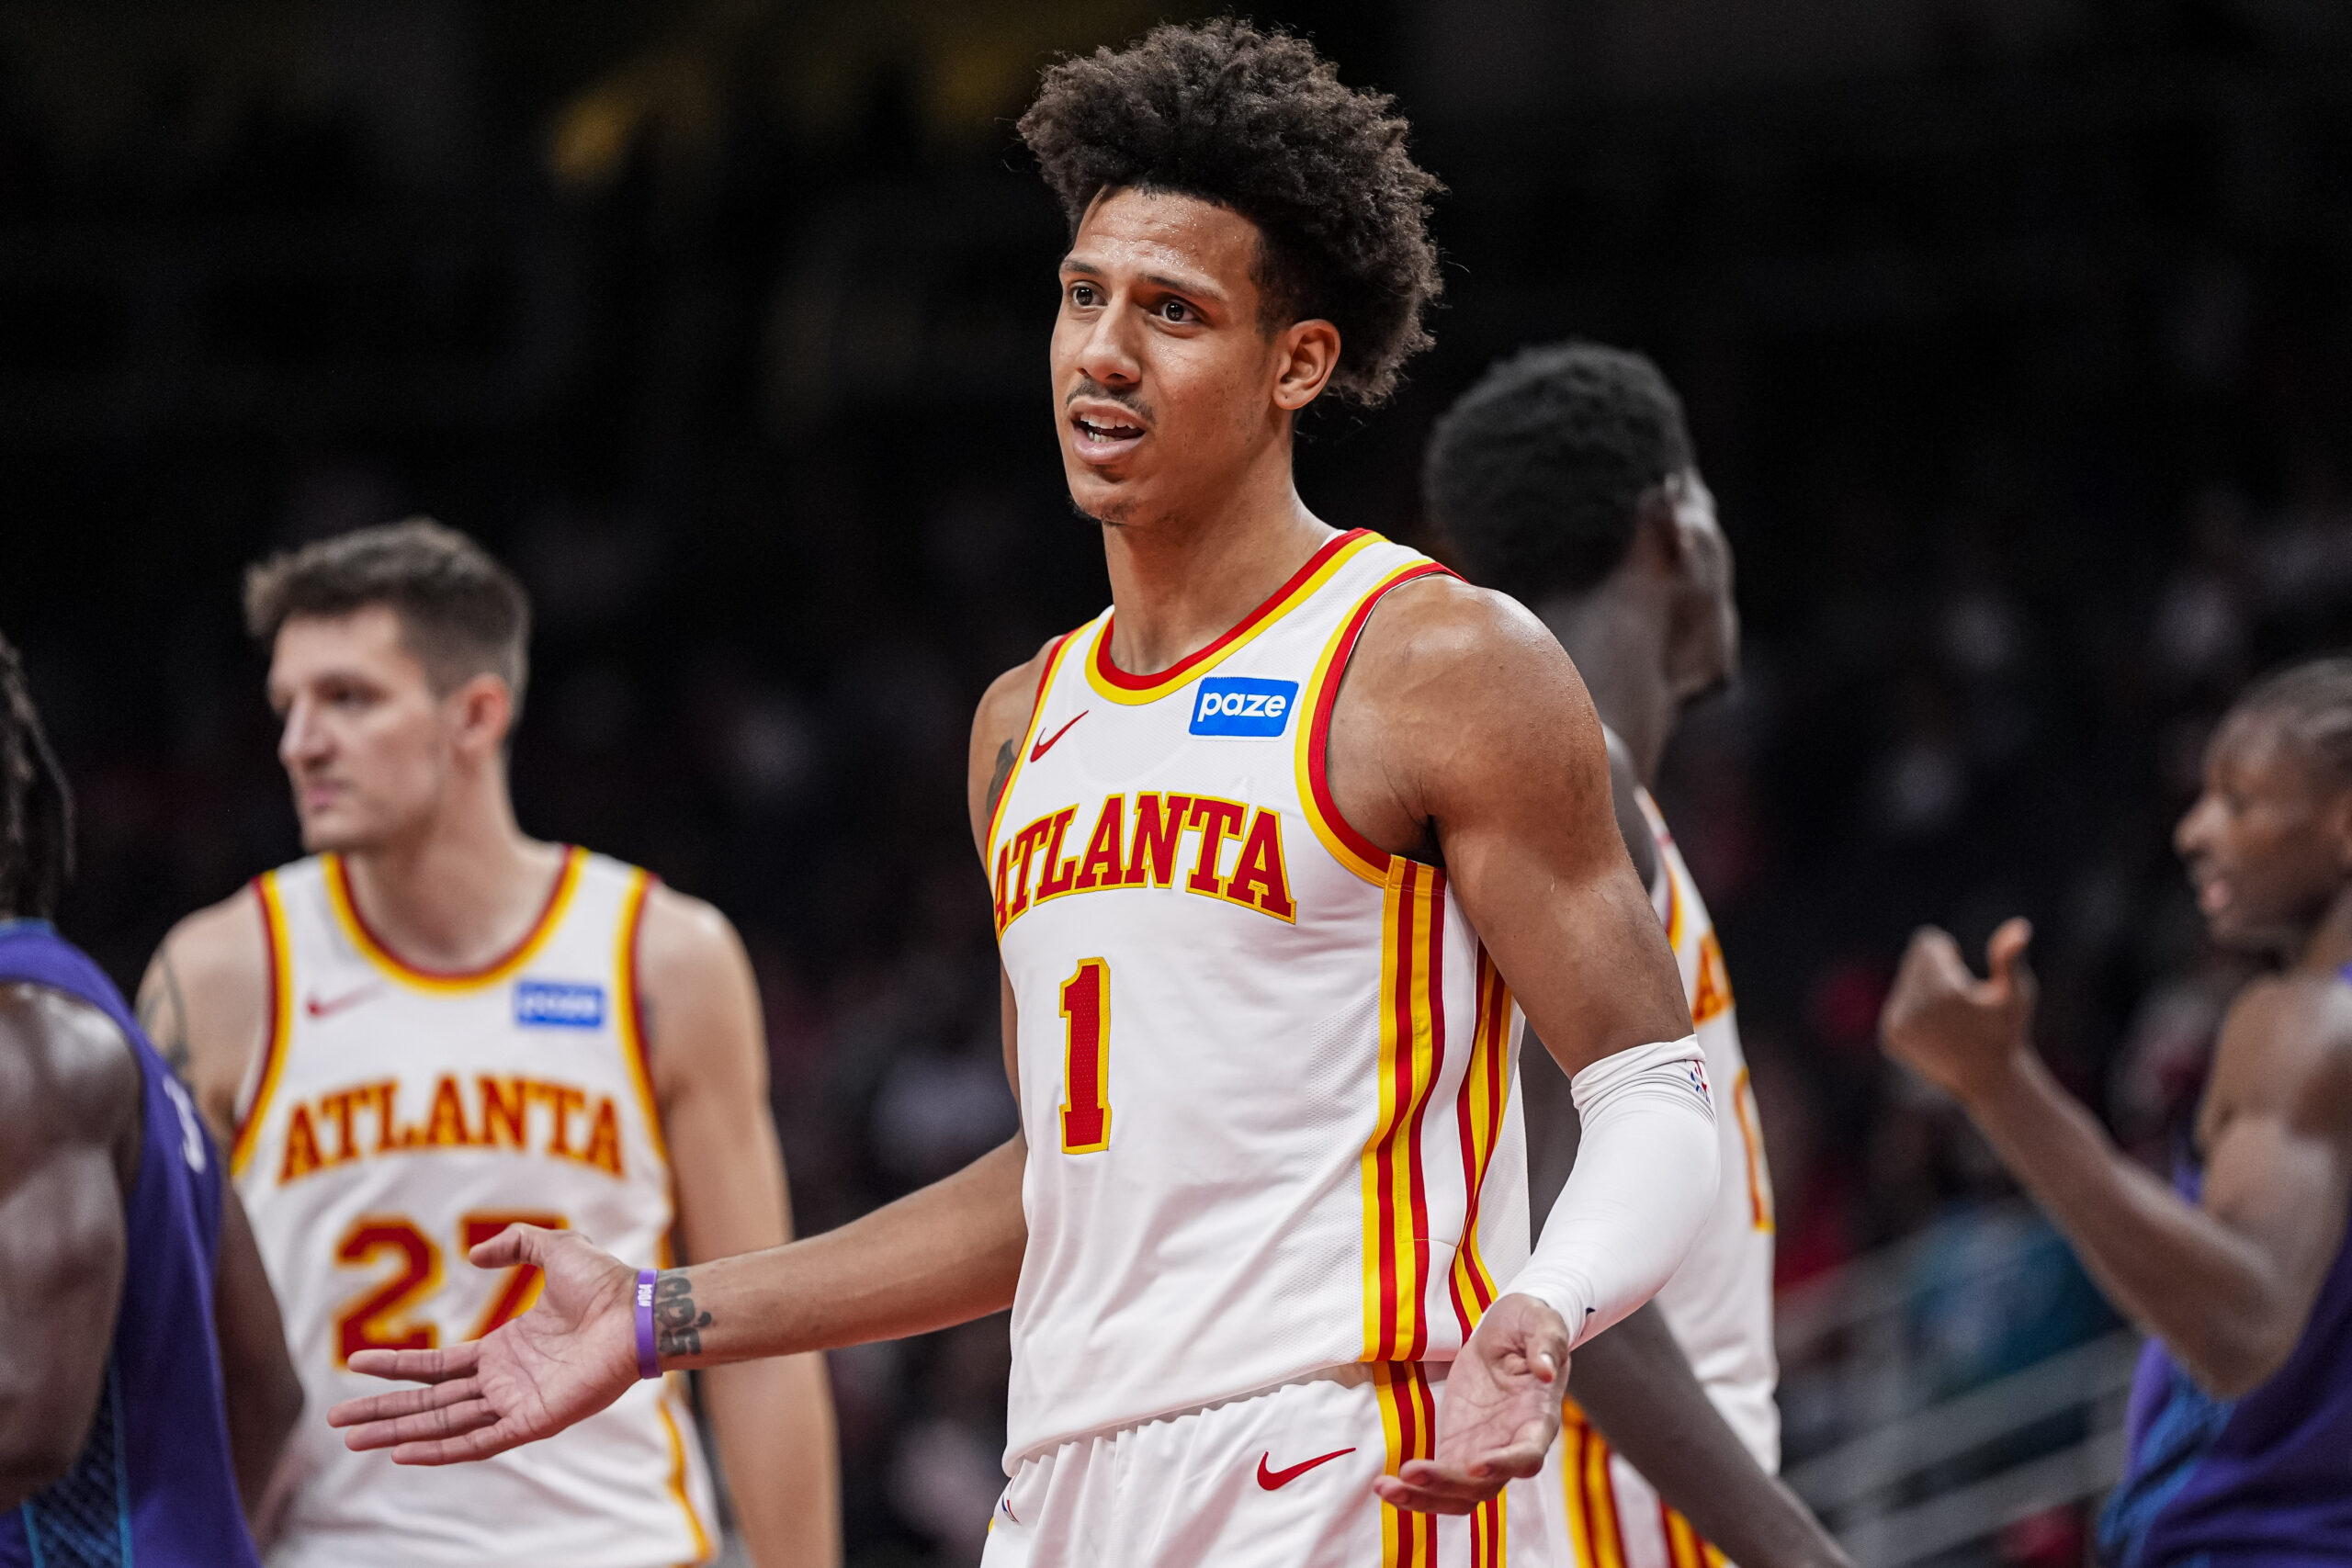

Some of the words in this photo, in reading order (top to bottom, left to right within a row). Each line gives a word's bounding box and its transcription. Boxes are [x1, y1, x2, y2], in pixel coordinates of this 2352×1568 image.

[1197, 692, 1286, 723] paze
[995, 791, 1296, 940] ATLANTA
[279, 1073, 627, 1185] ATLANTA
[1059, 956, 1111, 1155] 1
[334, 1213, 570, 1368] 27
